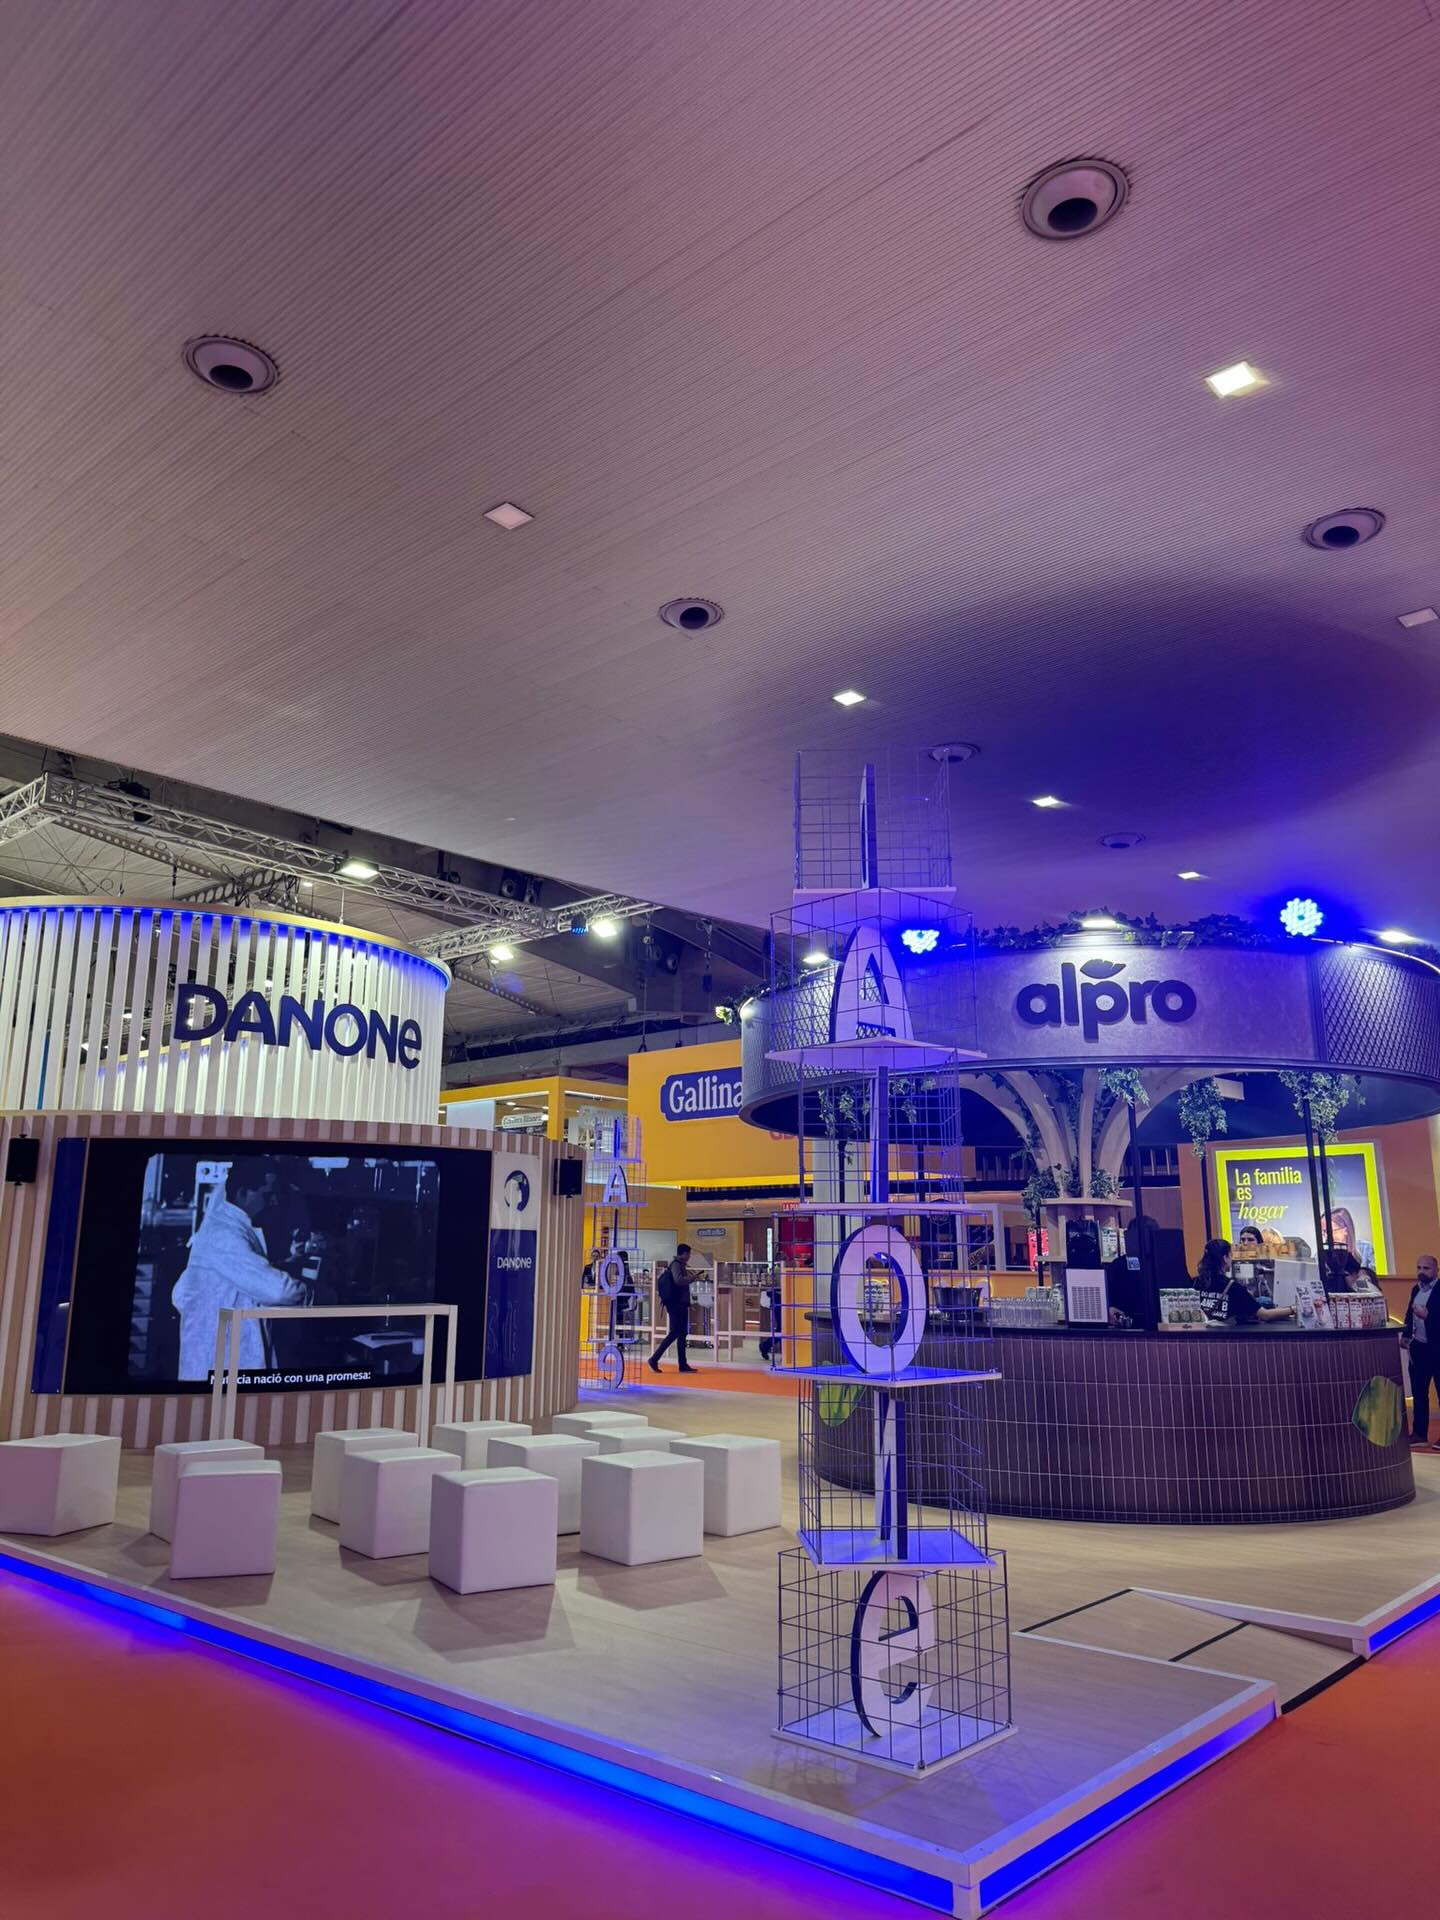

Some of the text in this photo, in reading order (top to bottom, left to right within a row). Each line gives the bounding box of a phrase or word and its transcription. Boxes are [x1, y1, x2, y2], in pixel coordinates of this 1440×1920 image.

[1016, 962, 1197, 1044] alpro
[669, 1075, 743, 1114] Gallina
[1235, 1166, 1303, 1186] La familia
[1236, 1185, 1252, 1201] es
[1238, 1201, 1288, 1224] hogar
[253, 1373, 282, 1385] nació
[284, 1375, 303, 1384] con
[305, 1374, 325, 1383] una
[326, 1371, 371, 1385] promesa:
